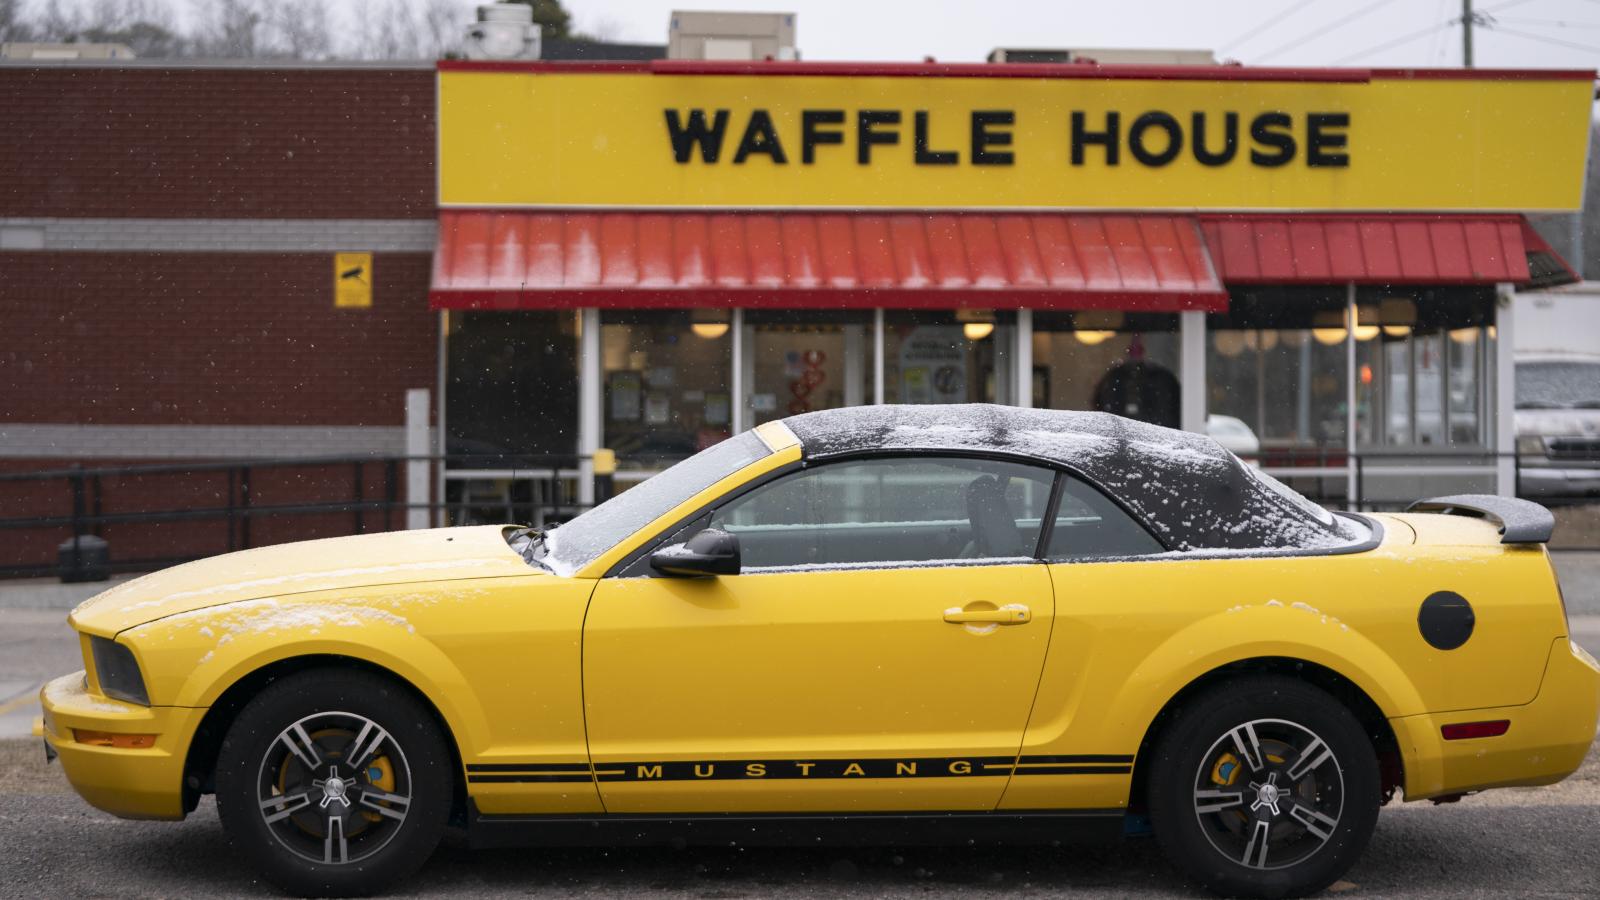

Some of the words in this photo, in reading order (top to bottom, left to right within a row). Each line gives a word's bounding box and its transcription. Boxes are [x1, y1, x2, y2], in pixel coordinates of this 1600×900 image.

[664, 108, 1015, 166] WAFFLE
[1070, 109, 1351, 169] HOUSE
[637, 761, 973, 779] MUSTANG
